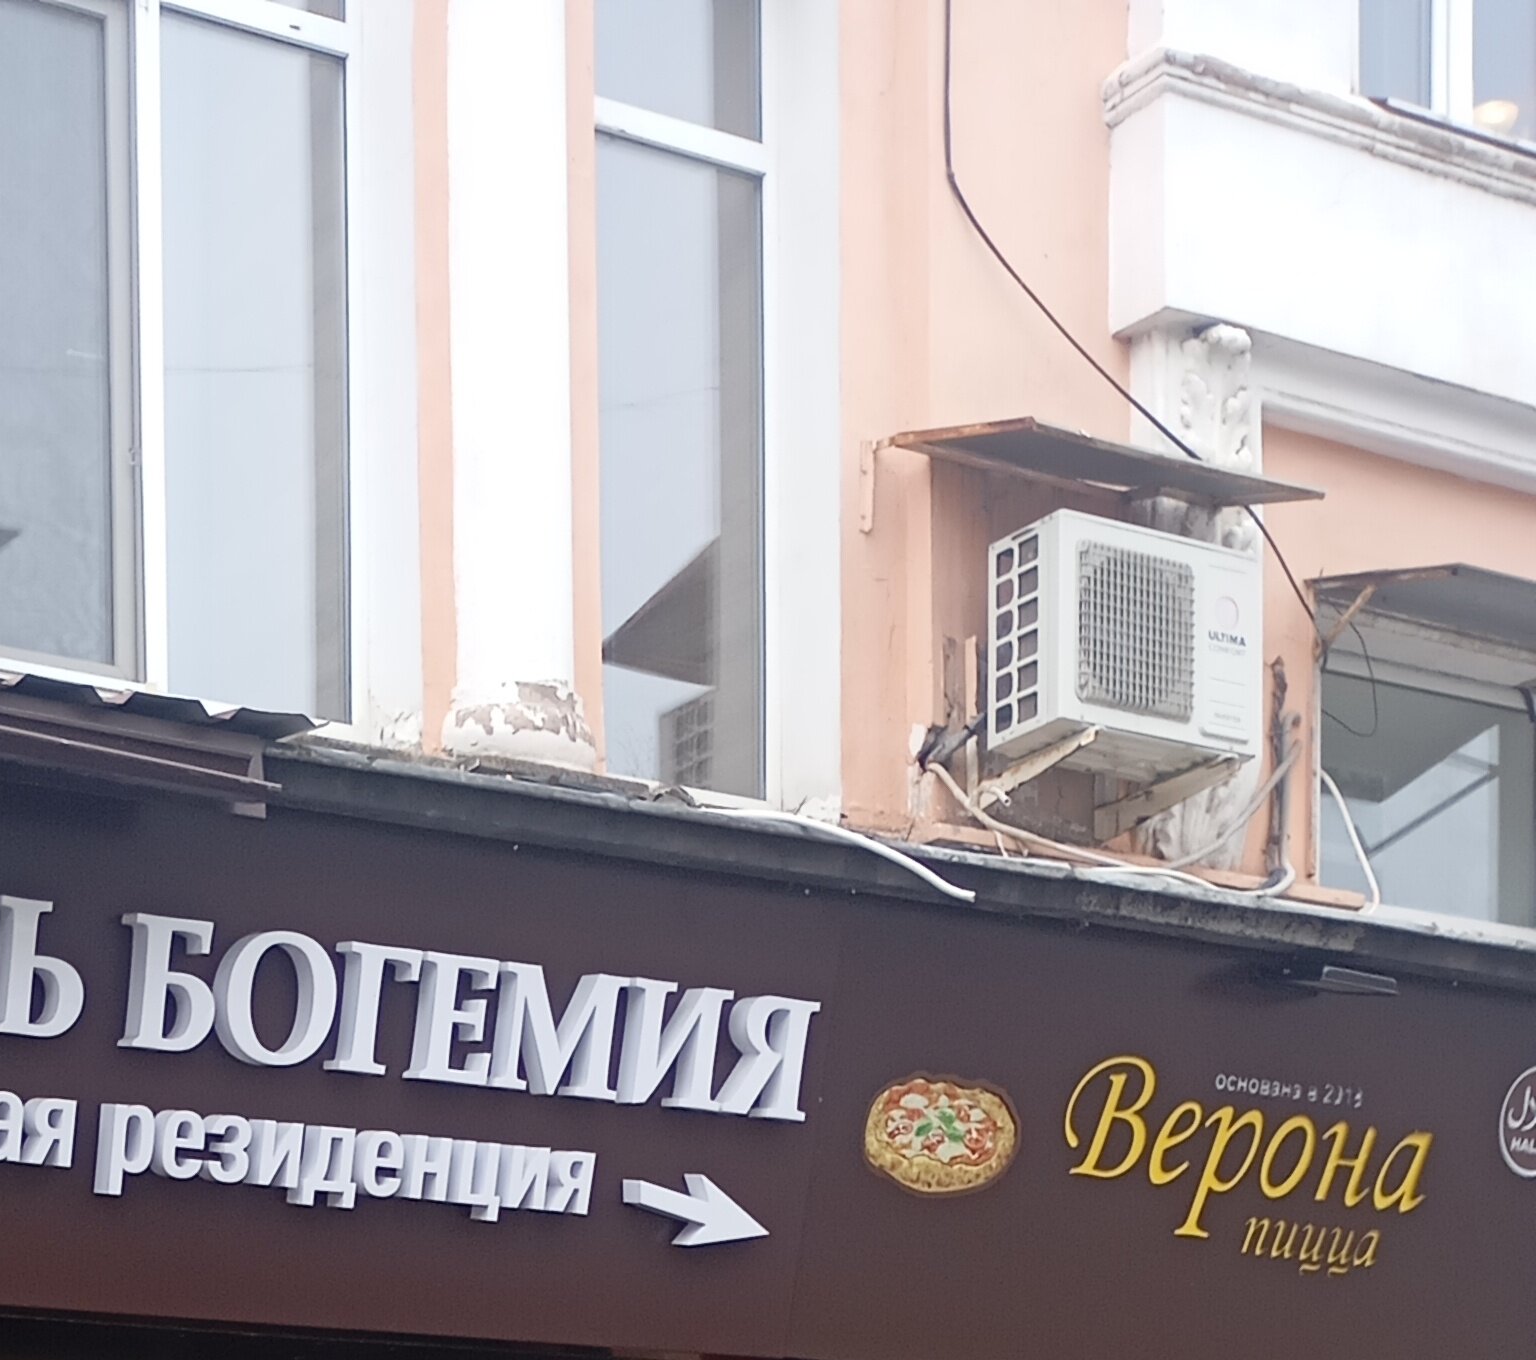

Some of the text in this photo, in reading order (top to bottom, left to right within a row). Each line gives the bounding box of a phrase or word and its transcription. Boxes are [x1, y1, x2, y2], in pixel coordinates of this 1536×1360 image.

[1208, 629, 1247, 647] ULTIMA
[117, 912, 821, 1122] БОГЕМИЯ
[94, 1102, 597, 1222] резиденция
[1064, 1055, 1434, 1239] Верона
[1240, 1215, 1381, 1277] пицца
